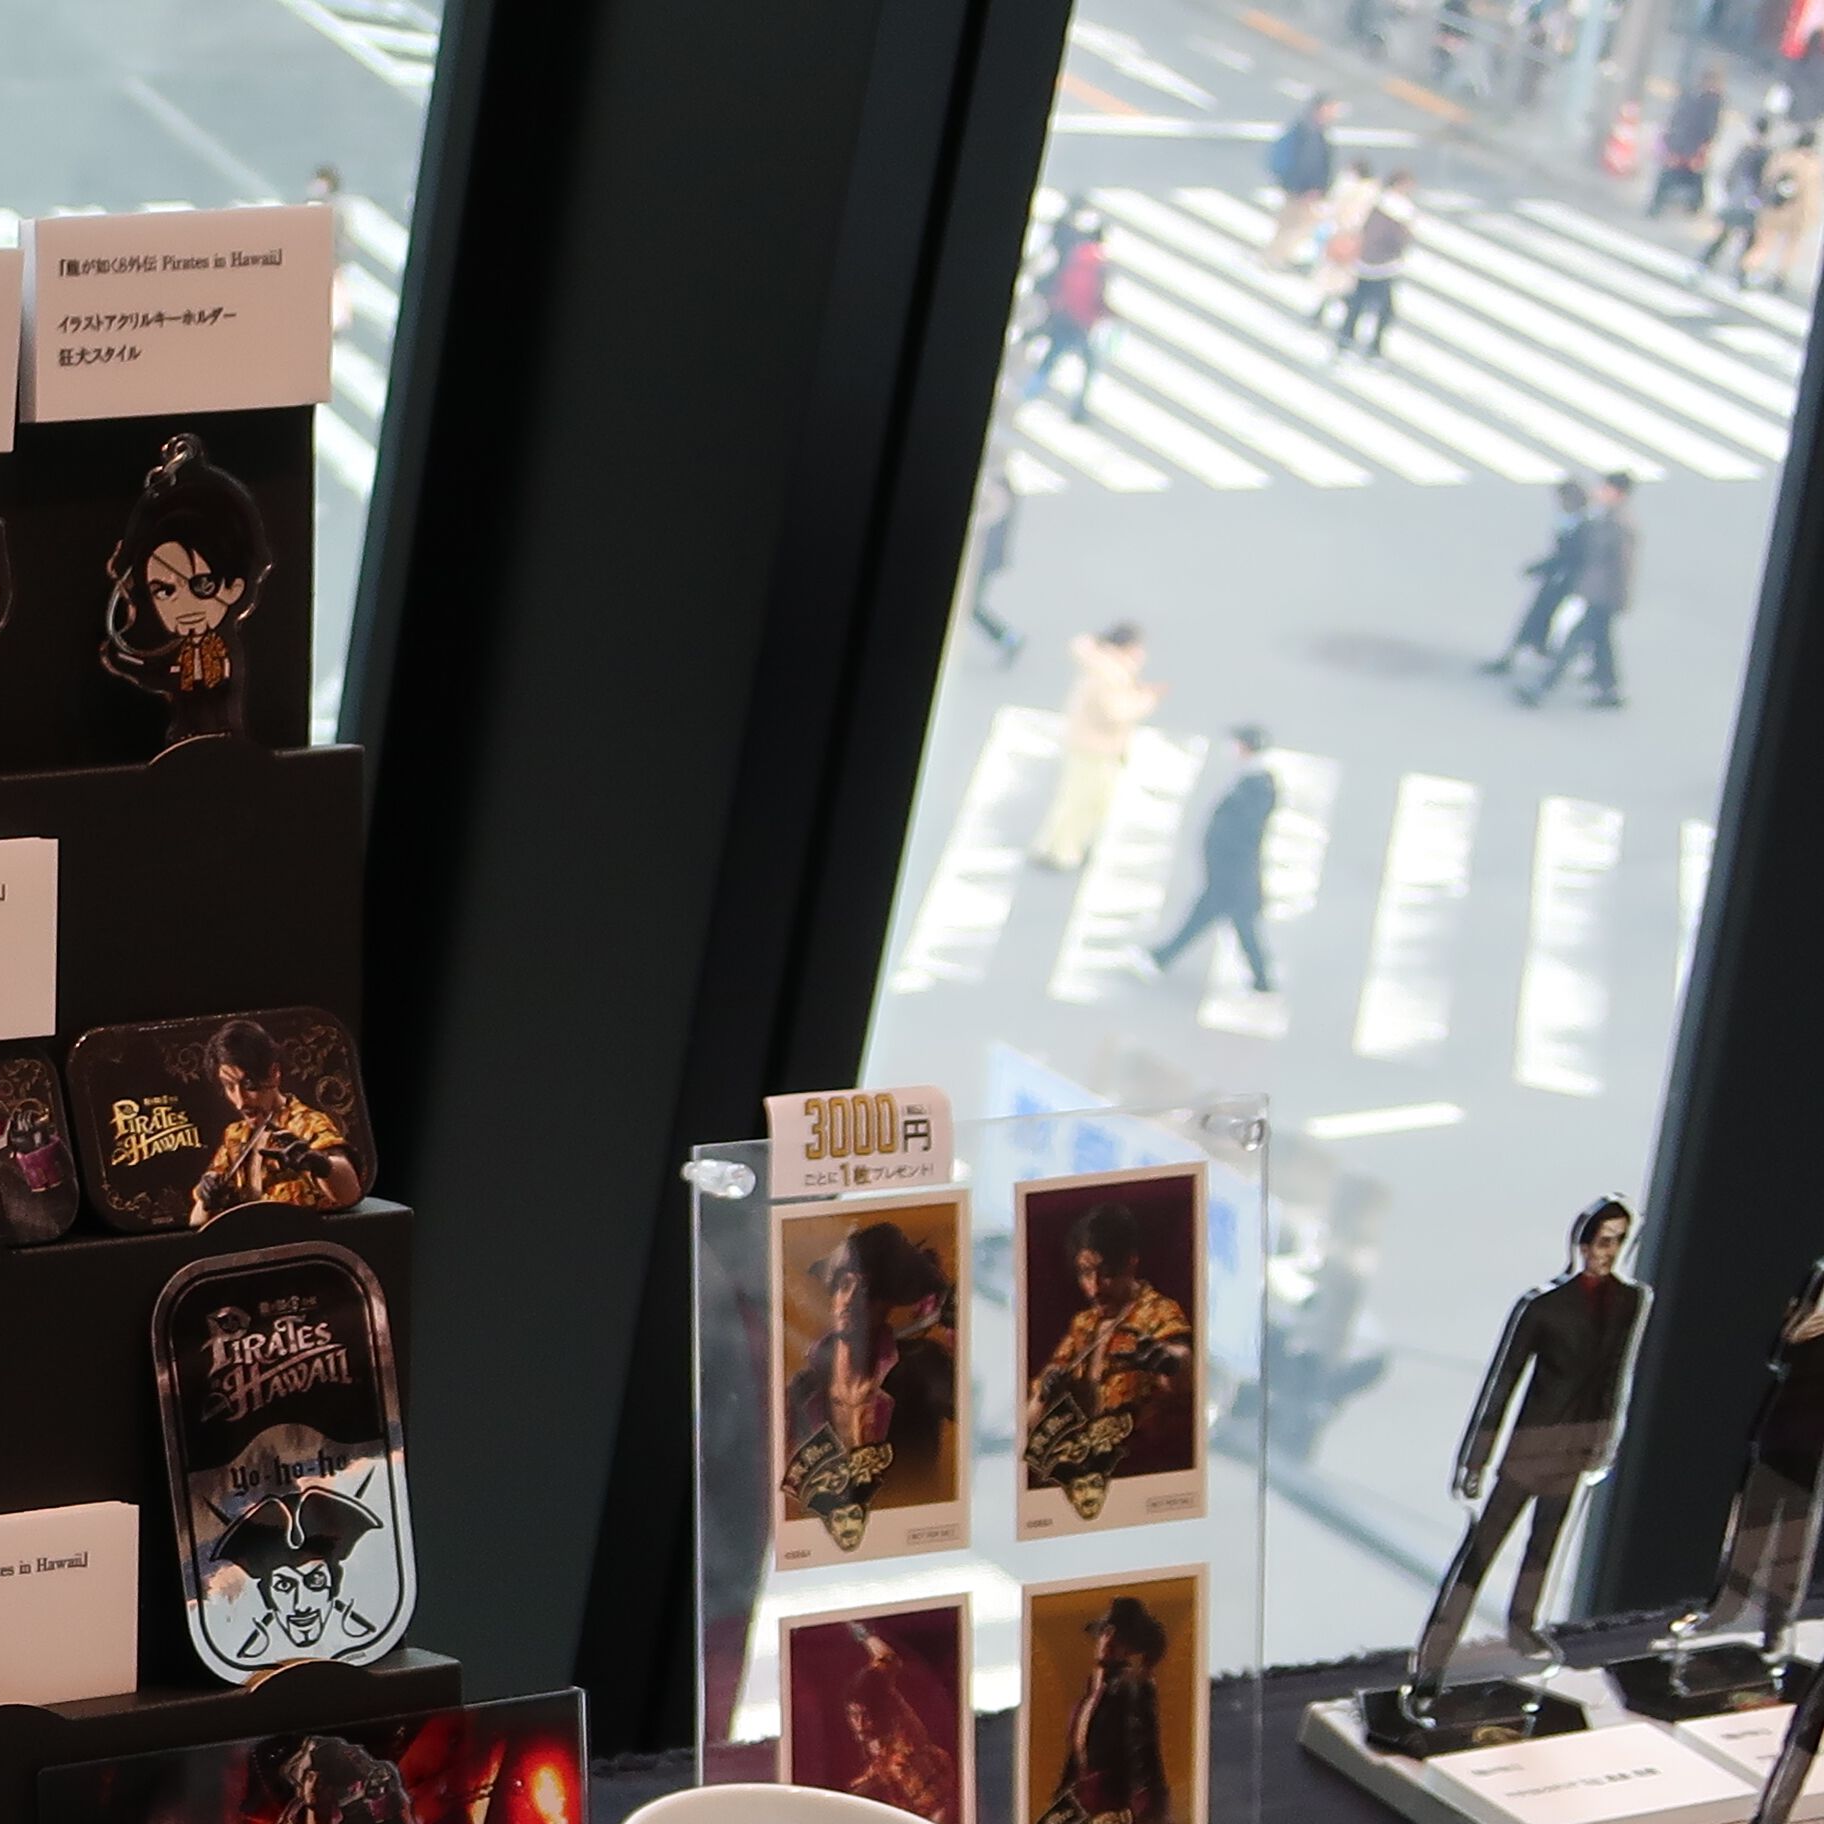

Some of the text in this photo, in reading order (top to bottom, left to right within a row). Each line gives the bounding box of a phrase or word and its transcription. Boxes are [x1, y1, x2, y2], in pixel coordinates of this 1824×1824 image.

[162, 253, 209, 273] Pirates
[213, 253, 226, 269] in
[58, 307, 237, 333] イラストアクリルキーホルダー
[111, 1099, 189, 1140] PIRATES
[19, 1559, 32, 1576] in
